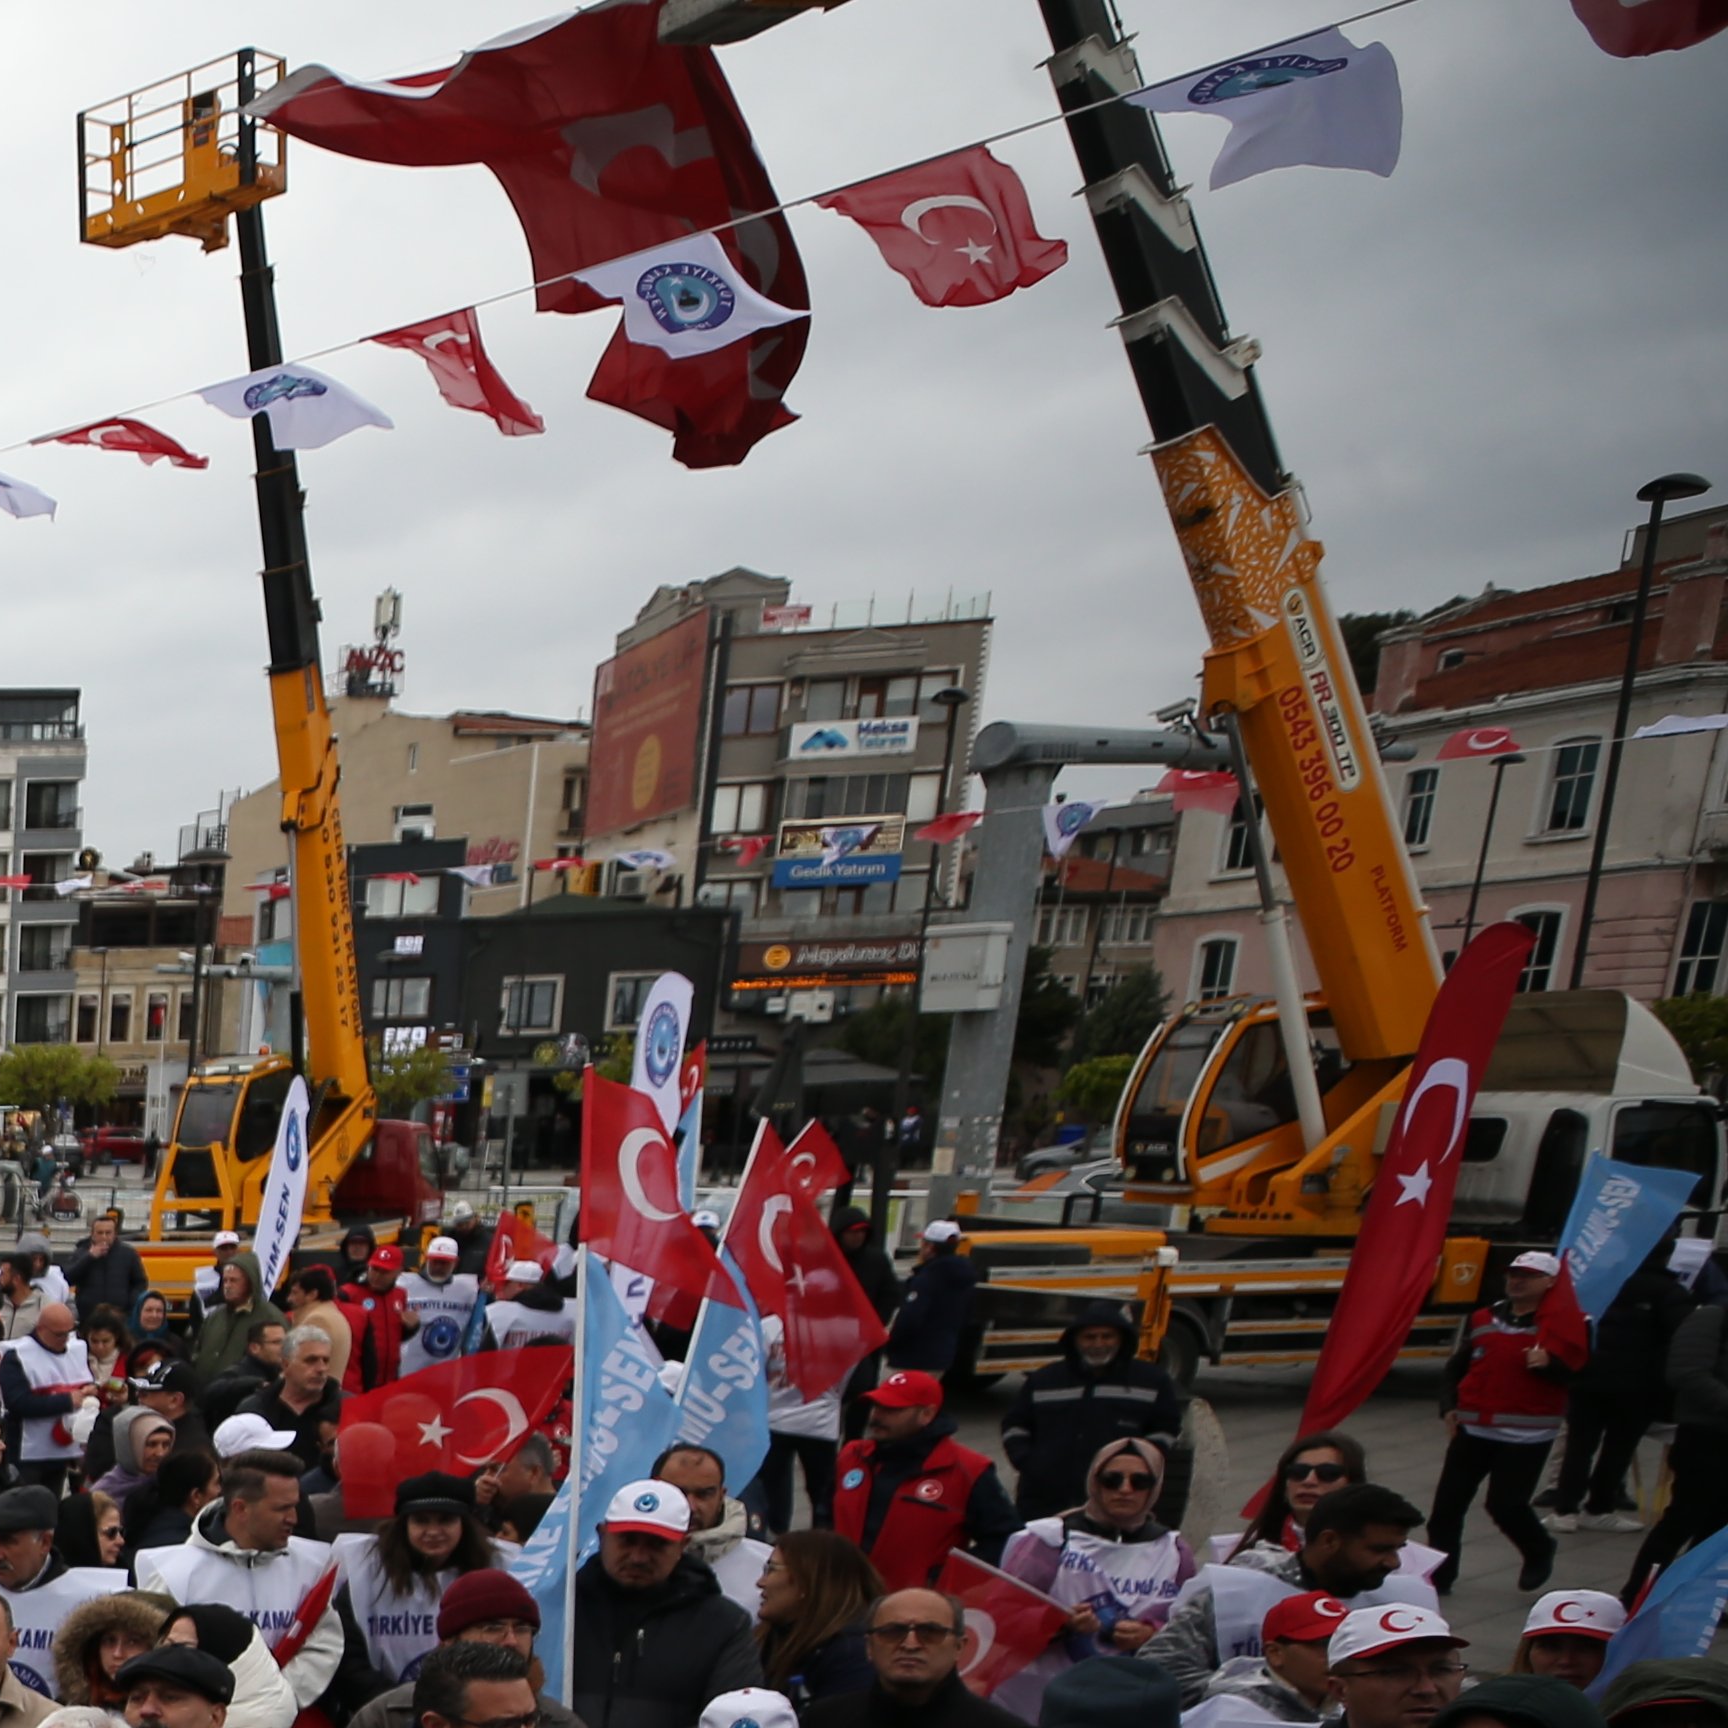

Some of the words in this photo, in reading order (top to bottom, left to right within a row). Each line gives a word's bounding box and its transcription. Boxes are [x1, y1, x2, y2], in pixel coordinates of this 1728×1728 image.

[1278, 685, 1317, 751] 0543
[1298, 753, 1334, 802] 396
[1316, 802, 1345, 840] 00
[789, 863, 834, 879] Gedik
[1327, 838, 1355, 874] 20
[1370, 864, 1410, 954] PLATFORM
